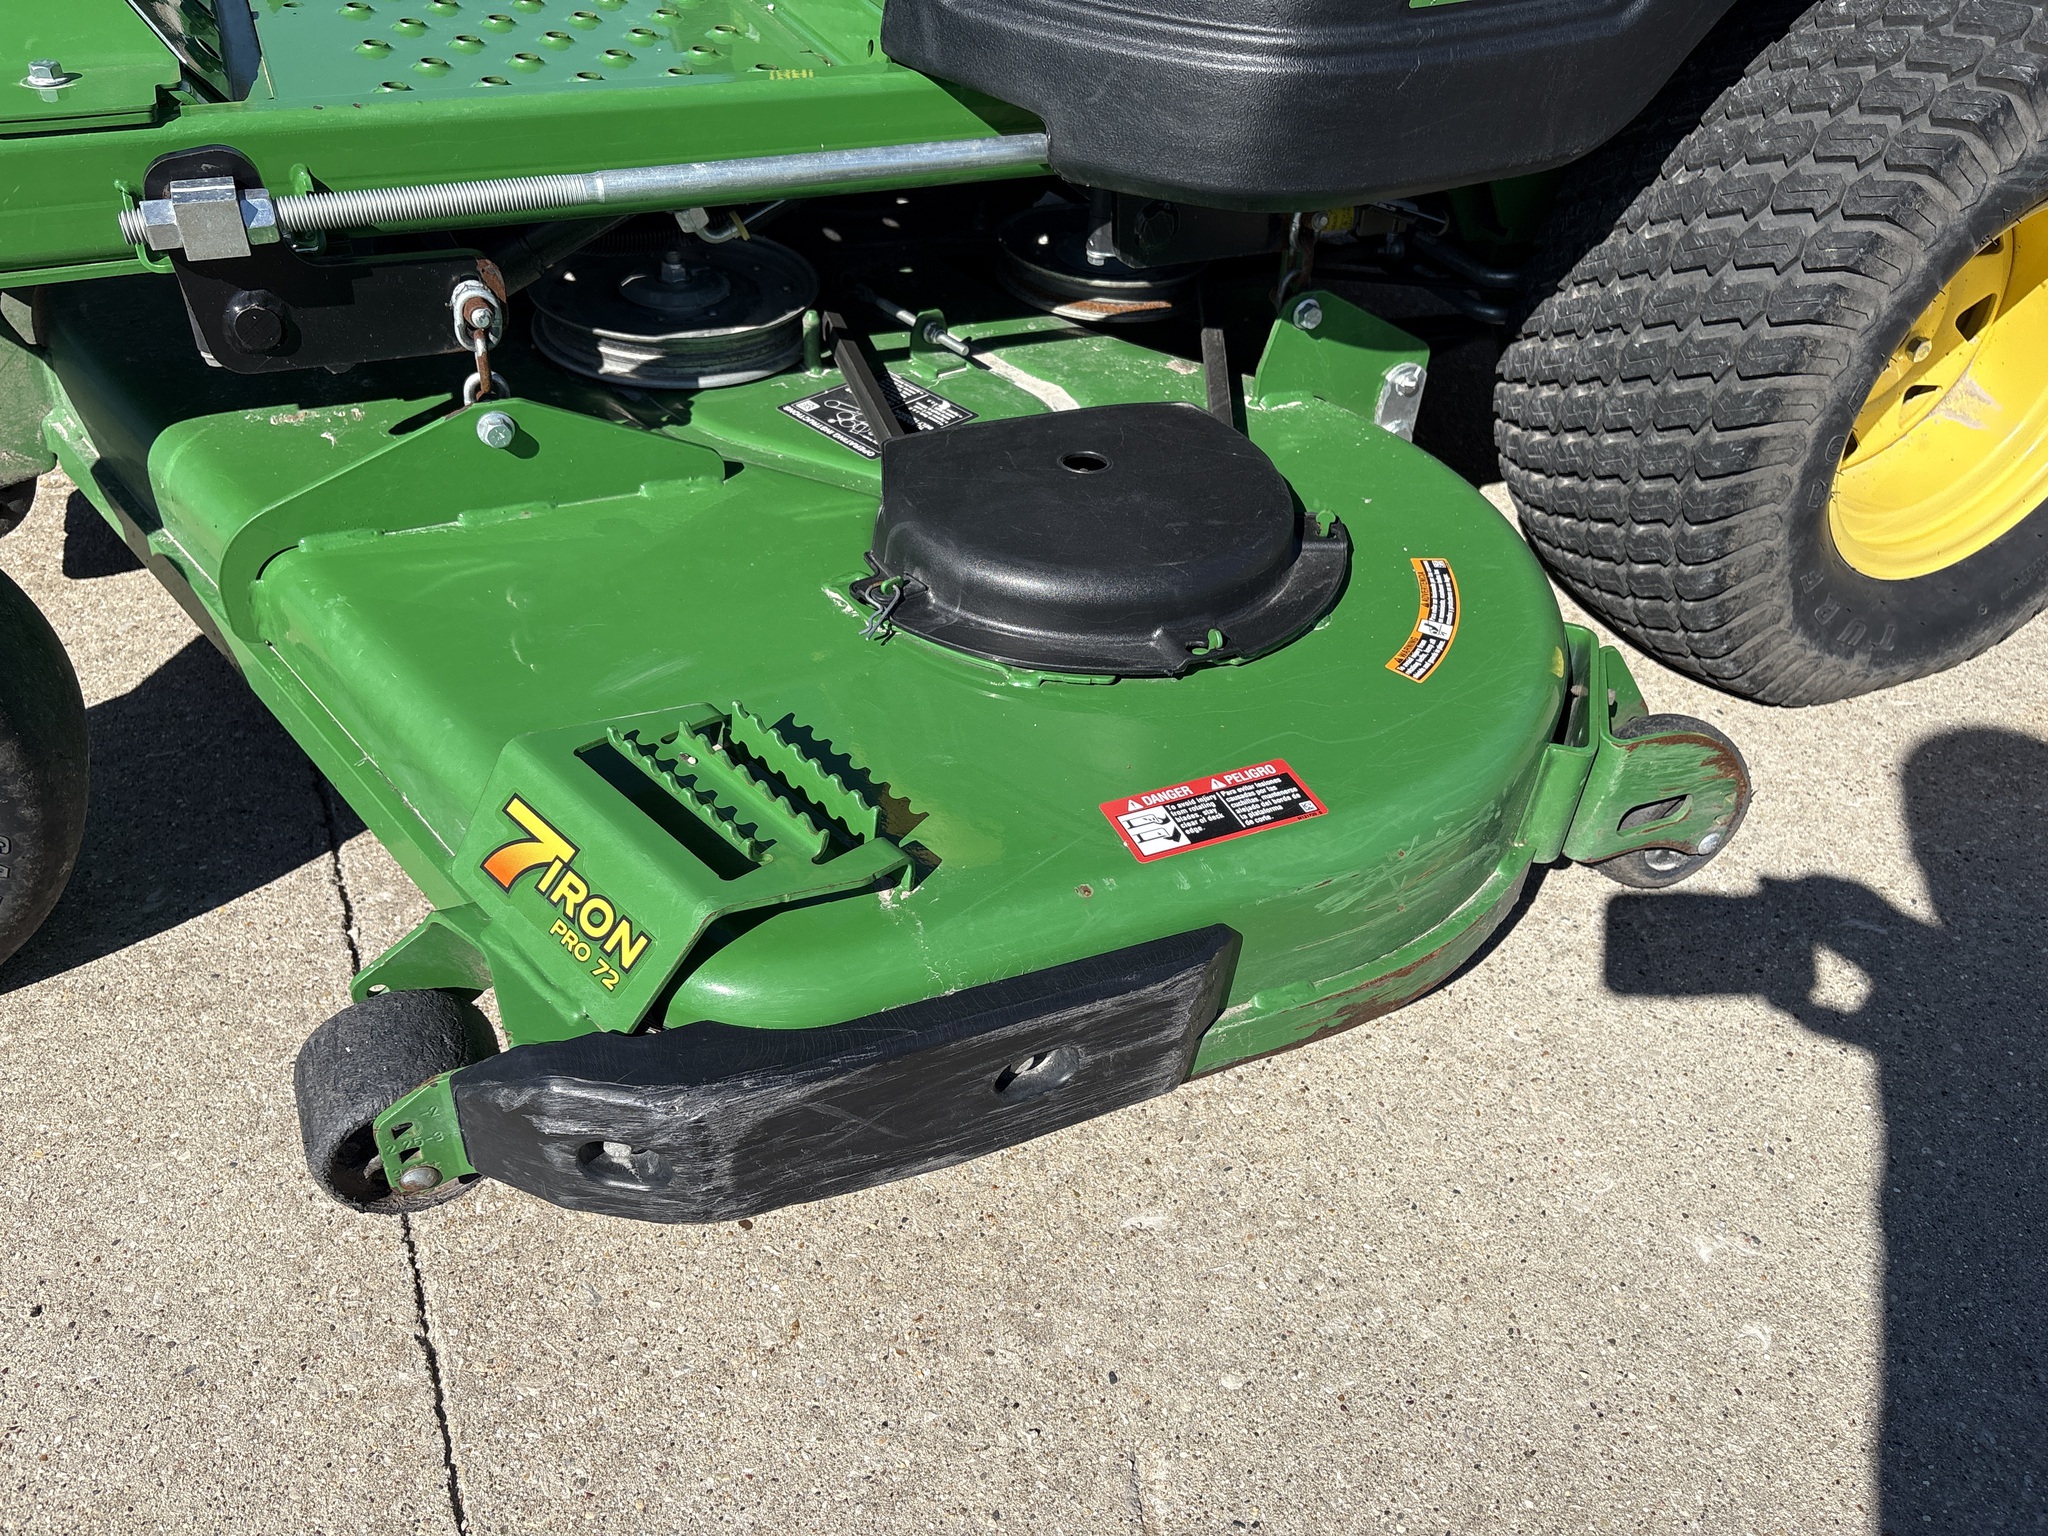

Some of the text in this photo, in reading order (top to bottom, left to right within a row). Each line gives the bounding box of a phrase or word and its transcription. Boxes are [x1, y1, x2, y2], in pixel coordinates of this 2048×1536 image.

[782, 405, 835, 435] INSTRUCTIONS
[832, 433, 875, 457] OPERATING
[1800, 569, 1896, 652] TURF
[1397, 636, 1419, 658] WARNING
[1223, 764, 1277, 785] PELIGRO
[1141, 785, 1194, 806] DANGER
[1220, 777, 1282, 797] Para evitar lesiones
[1225, 784, 1278, 802] causadas por las
[1260, 786, 1299, 800] mantenerse
[1170, 801, 1217, 817] from rotating
[1177, 798, 1196, 807] avoid
[1196, 793, 1217, 803] injury
[1235, 802, 1261, 814] alejado
[1260, 799, 1272, 808] del
[1272, 795, 1292, 805] borde
[1180, 812, 1225, 829] clear of deck
[1202, 807, 1218, 817] stay
[1247, 804, 1284, 818] plataforma
[1184, 826, 1206, 835] edge.
[480, 792, 652, 974] 7 IRON
[549, 917, 621, 993] PRO 72
